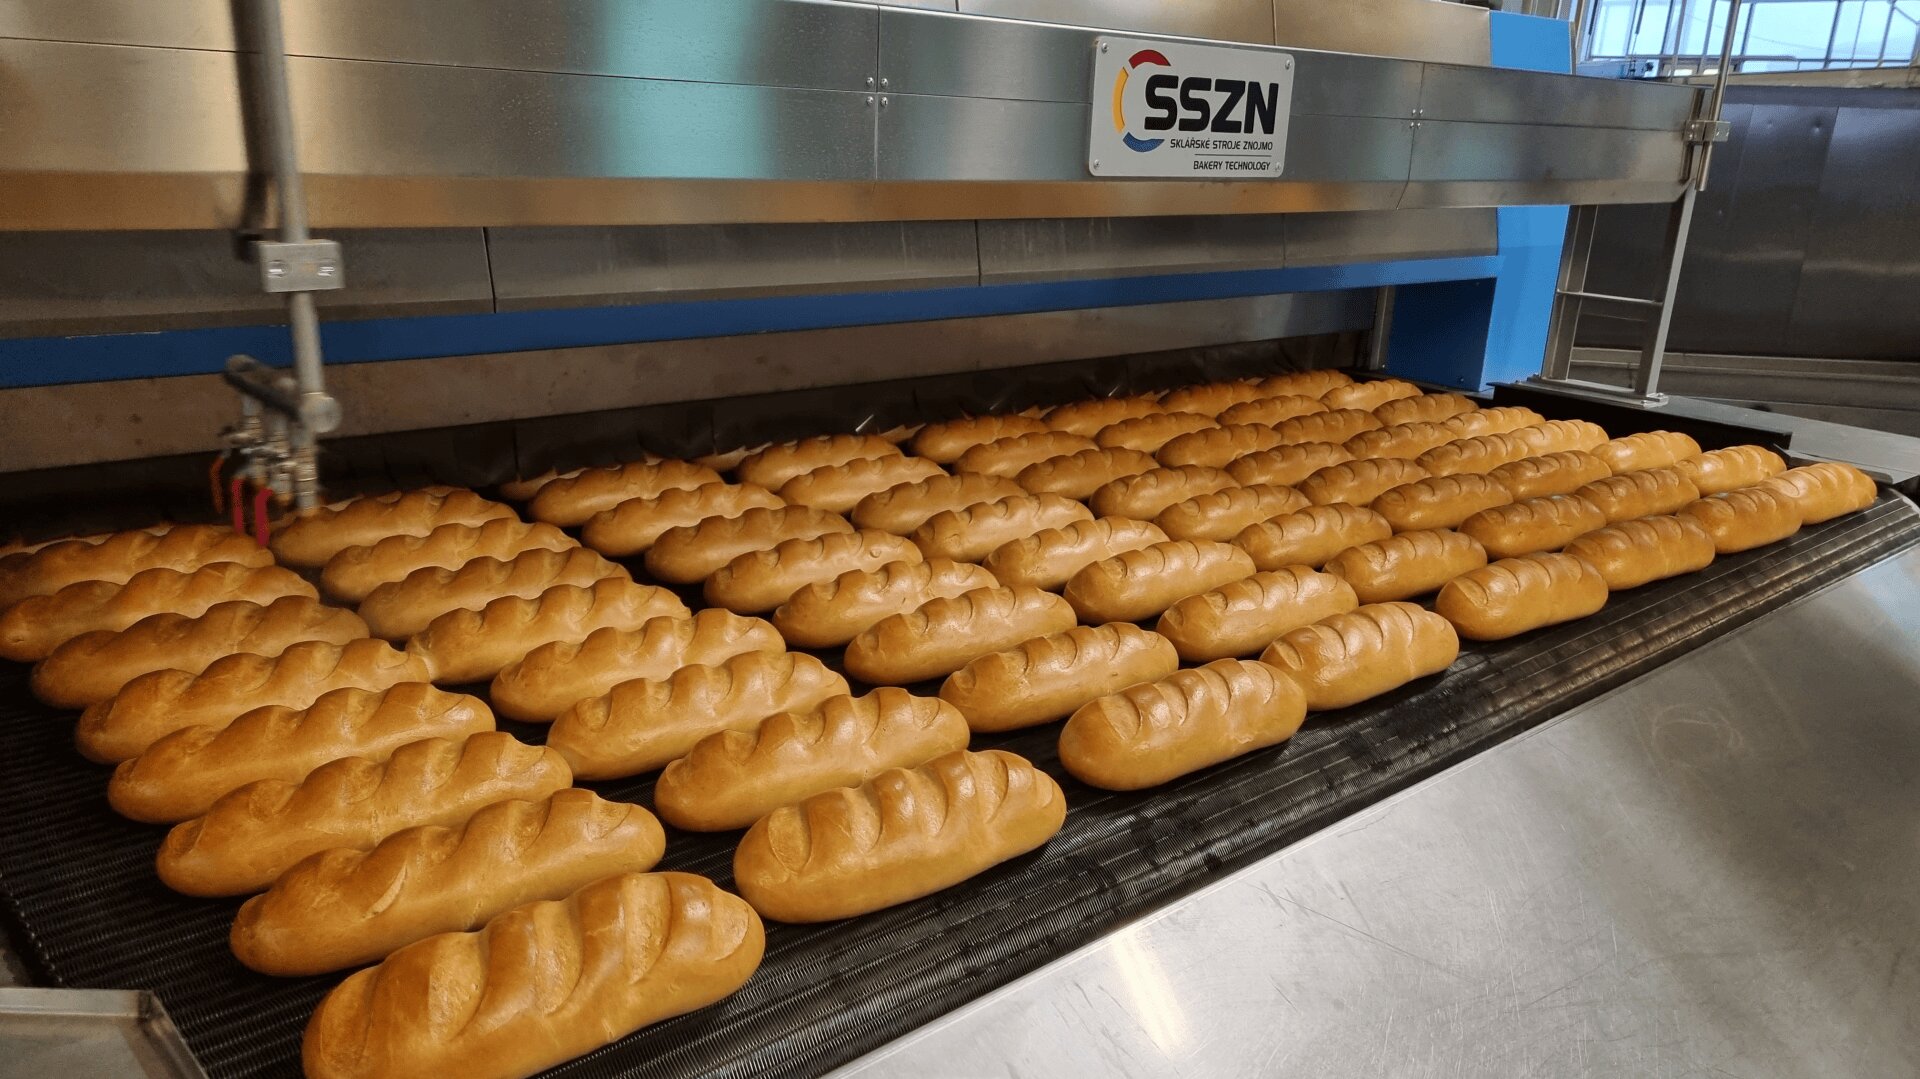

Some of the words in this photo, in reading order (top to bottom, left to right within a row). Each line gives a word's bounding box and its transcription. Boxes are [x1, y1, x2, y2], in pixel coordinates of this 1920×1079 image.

[1144, 74, 1279, 134] SSZN
[1170, 137, 1210, 149] SKLÁŘSKÉ
[1212, 140, 1241, 150] STROJE
[1243, 141, 1273, 150] ZNOJMO
[1193, 160, 1223, 170] BAKERY
[1225, 161, 1270, 171] TECHNOLOGY
